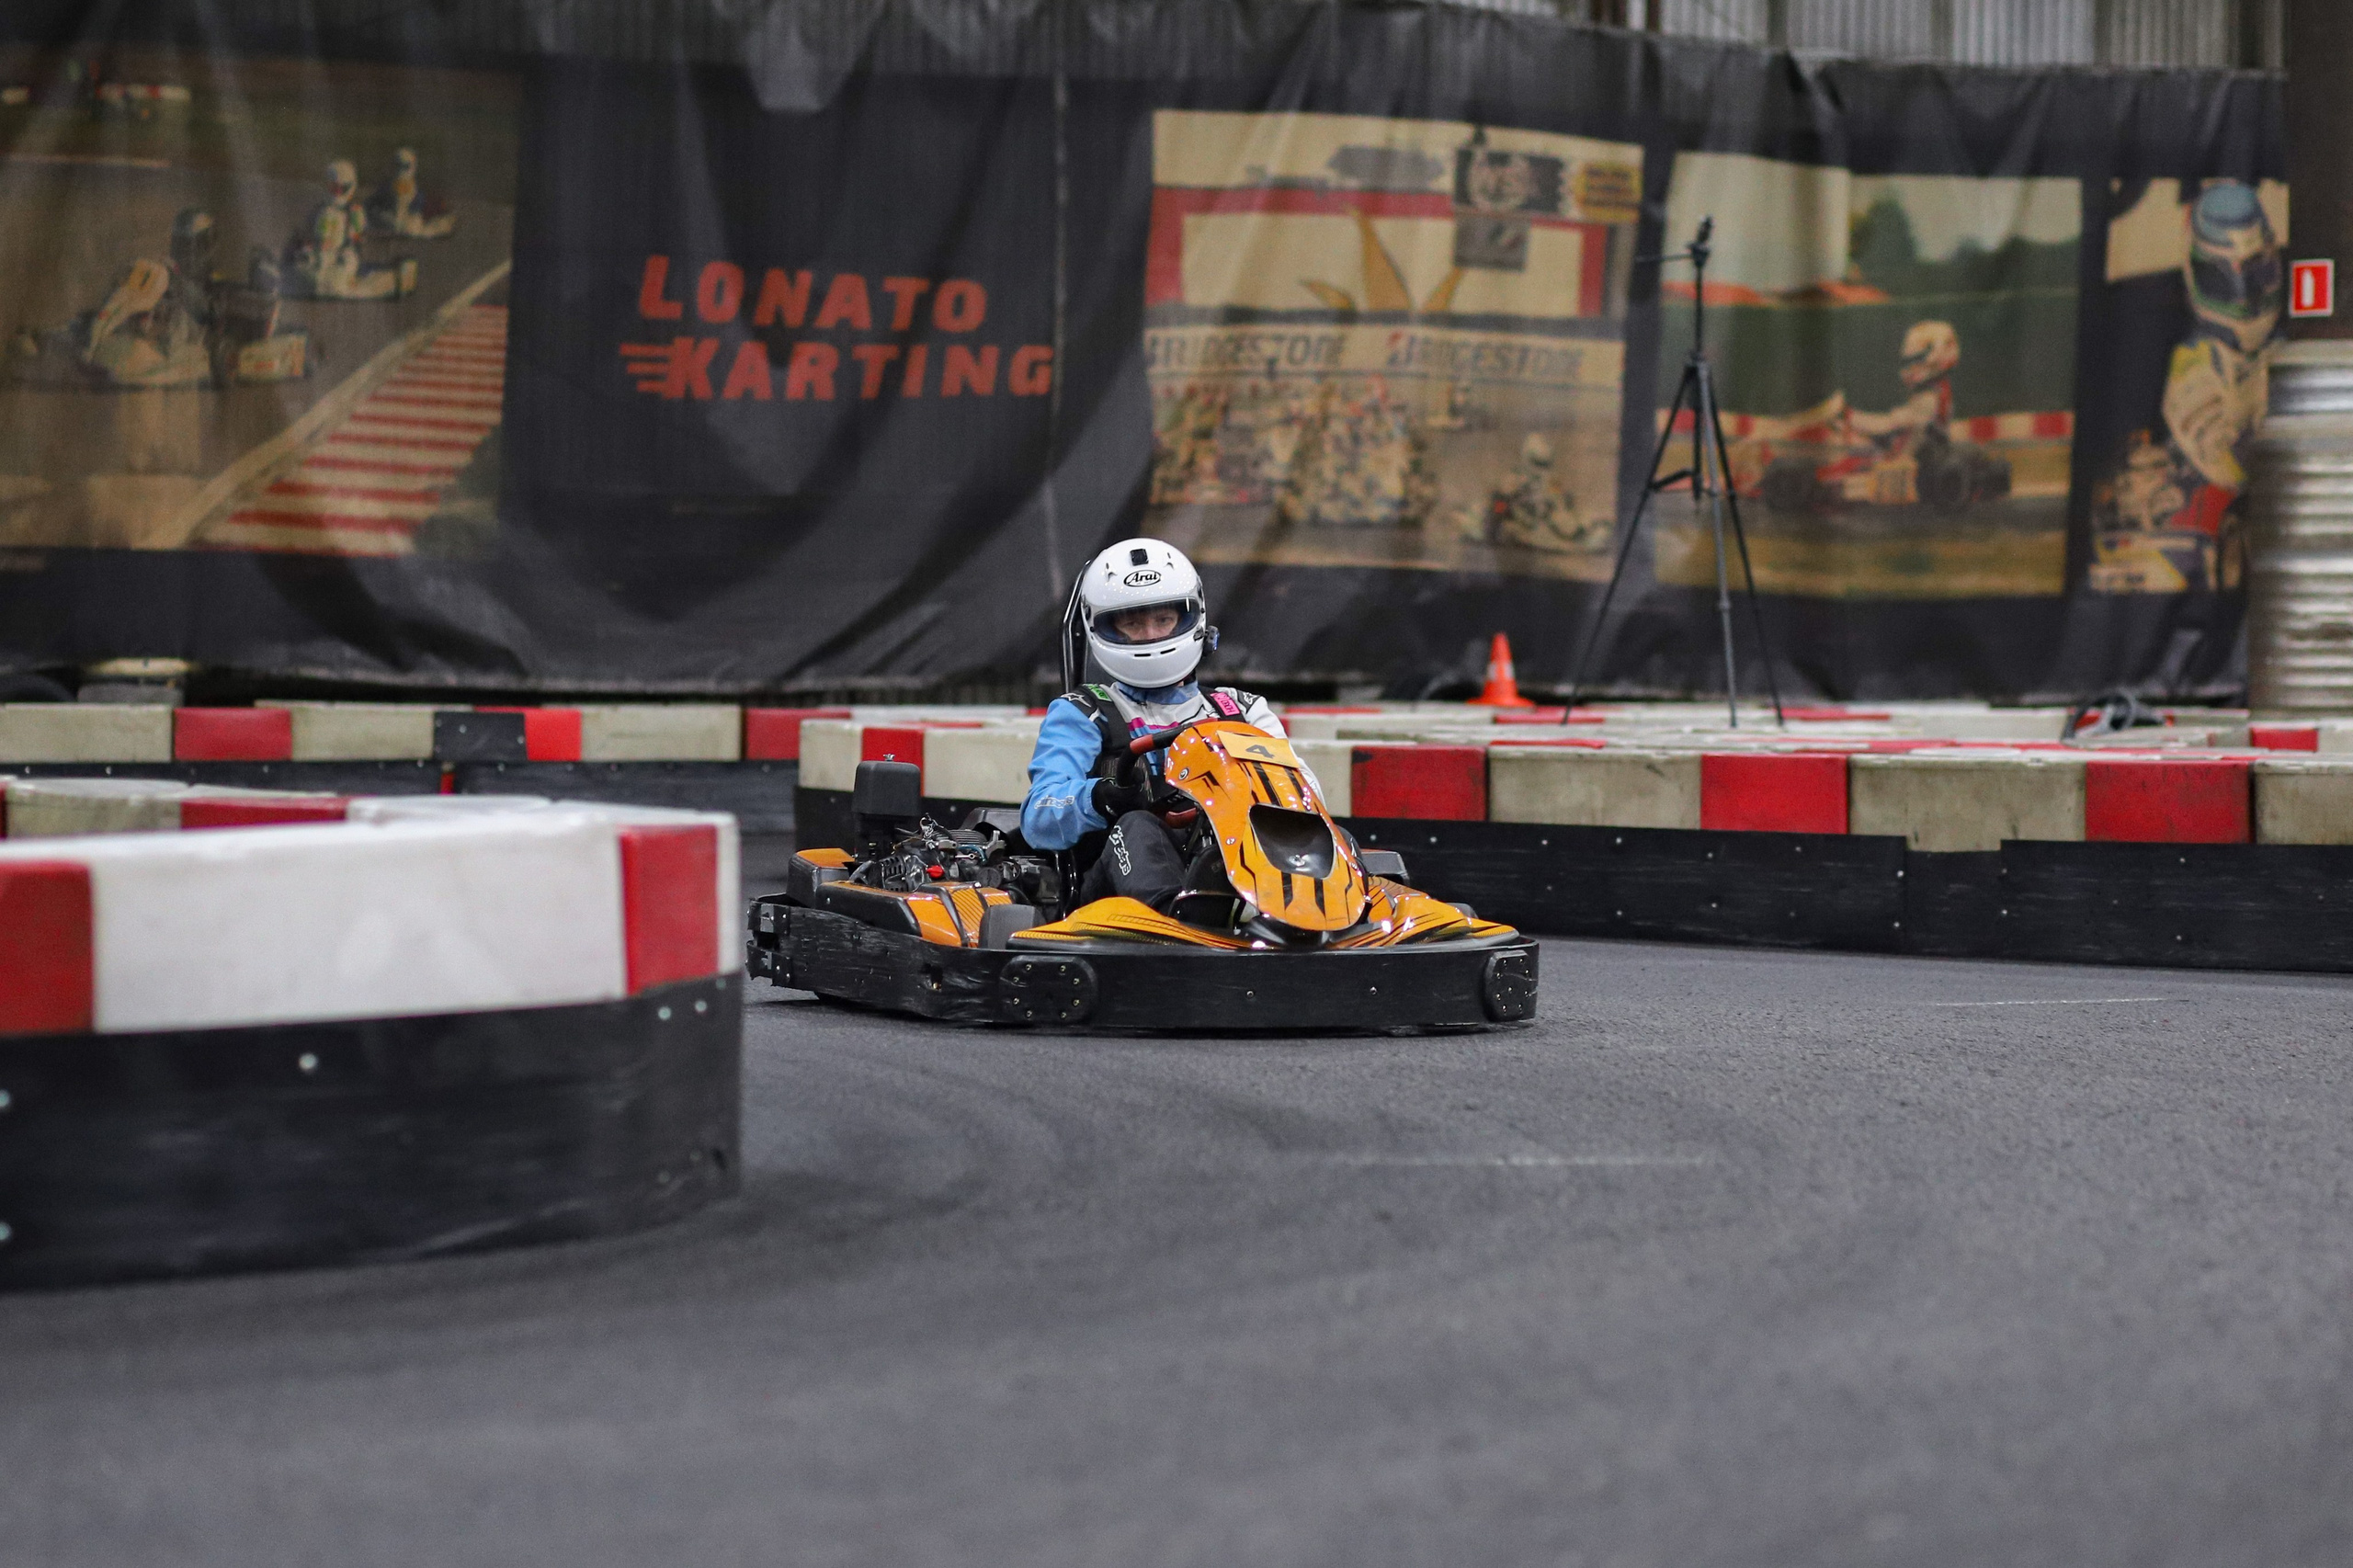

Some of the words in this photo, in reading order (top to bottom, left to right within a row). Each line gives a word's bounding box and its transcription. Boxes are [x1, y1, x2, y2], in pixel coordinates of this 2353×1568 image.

[639, 255, 987, 333] LONATO
[660, 336, 1054, 401] KARTING
[1127, 572, 1158, 585] Arai
[1245, 744, 1276, 759] 4
